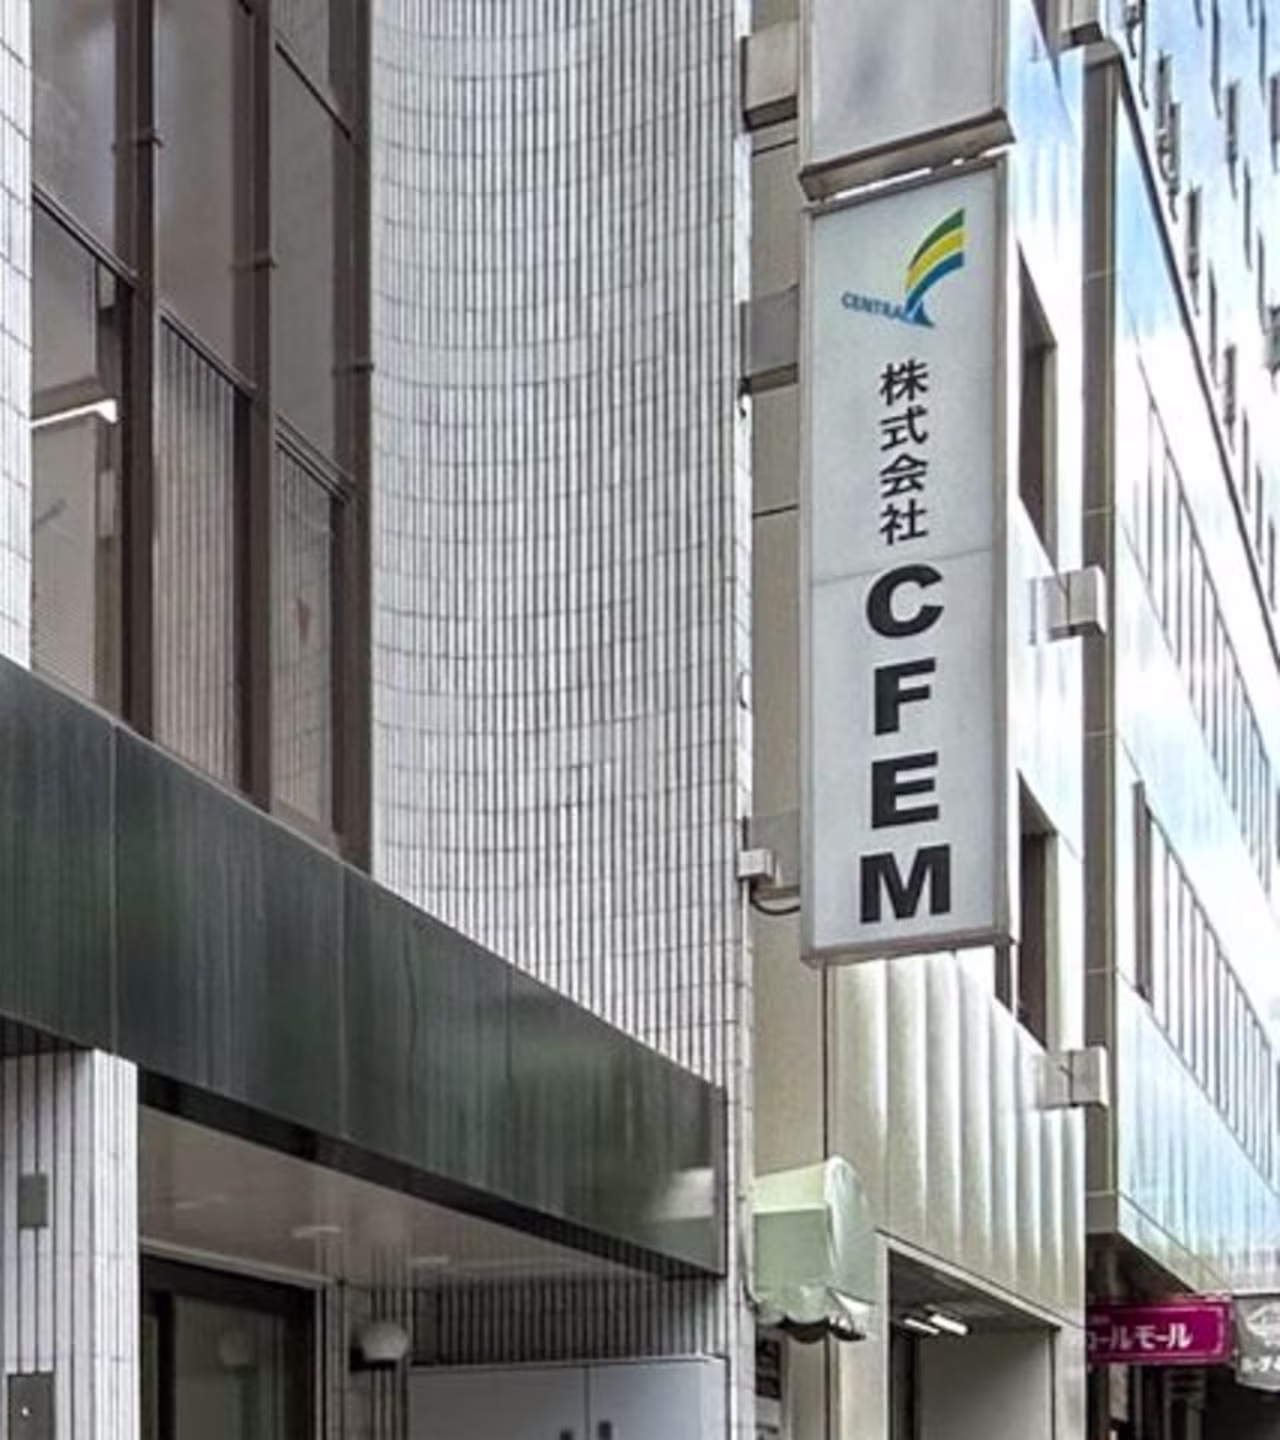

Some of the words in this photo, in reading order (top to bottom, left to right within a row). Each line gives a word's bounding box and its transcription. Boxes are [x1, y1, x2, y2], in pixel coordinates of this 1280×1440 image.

[879, 358, 929, 546] 株式会社
[859, 563, 952, 924] CFEM
